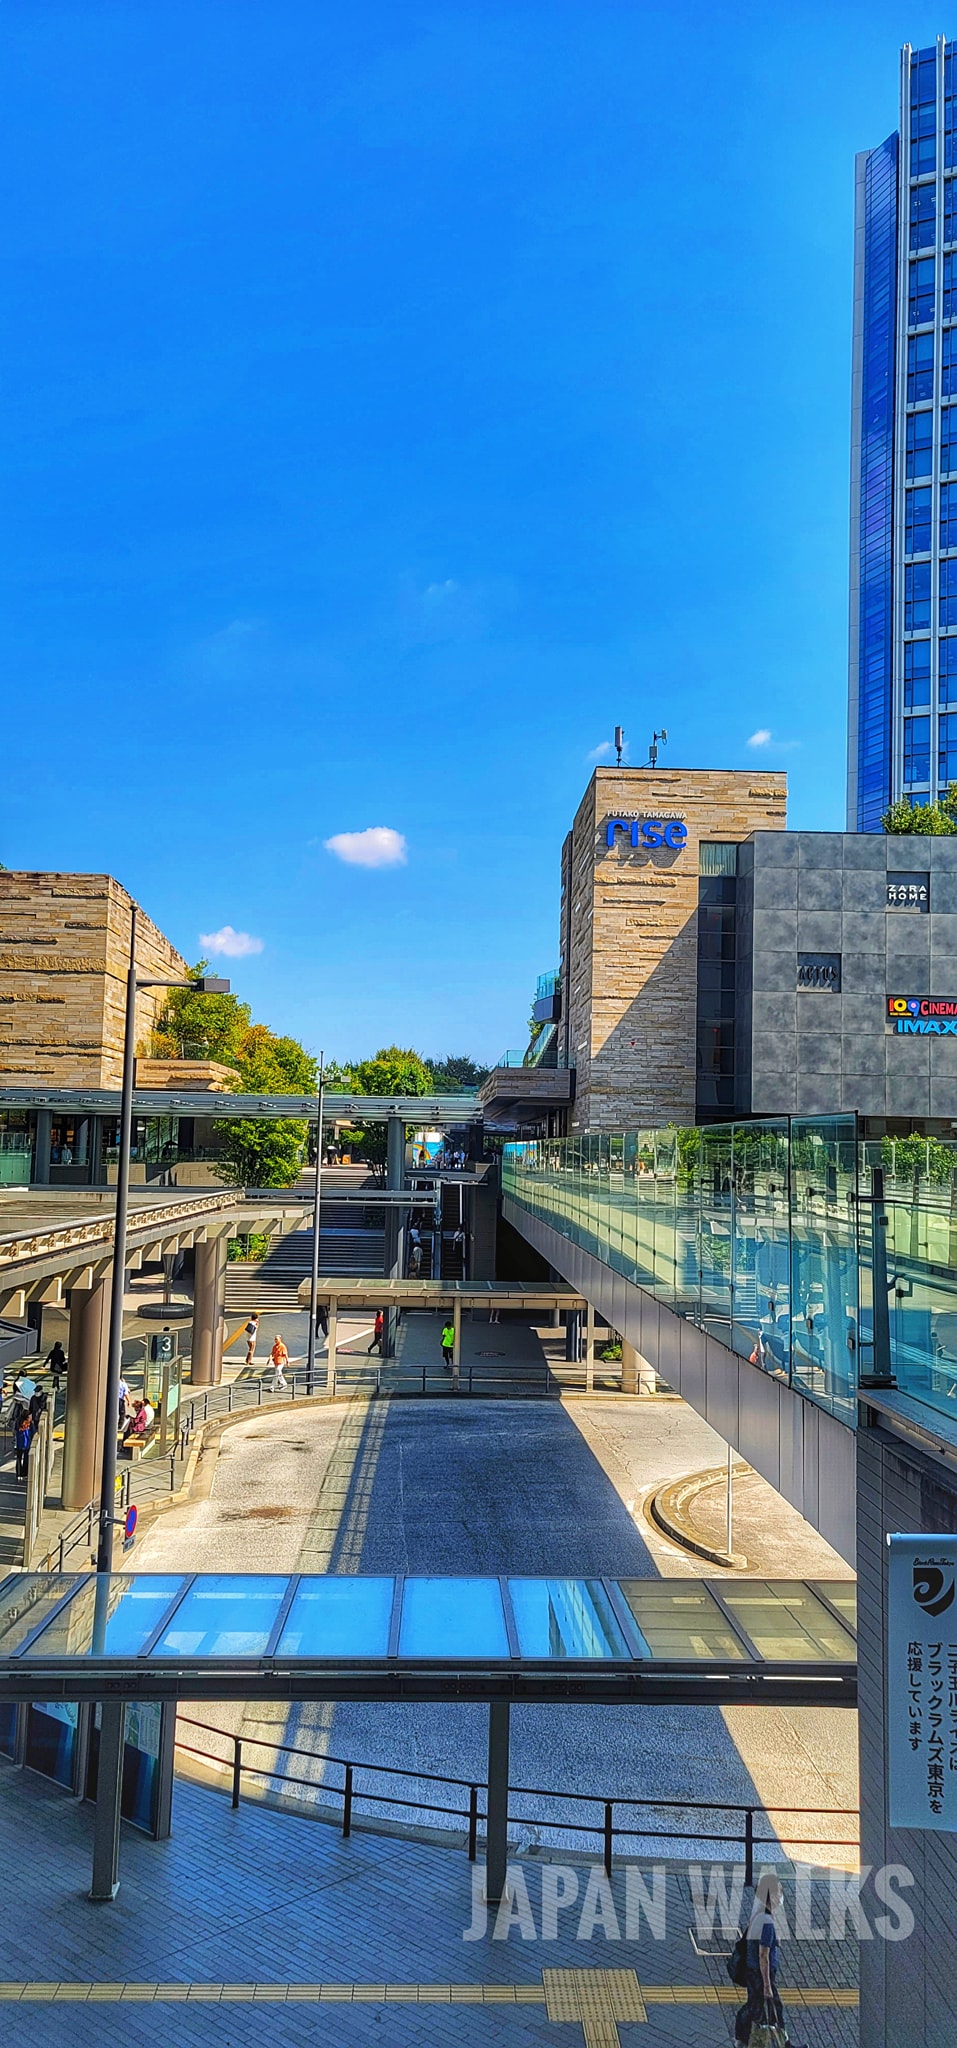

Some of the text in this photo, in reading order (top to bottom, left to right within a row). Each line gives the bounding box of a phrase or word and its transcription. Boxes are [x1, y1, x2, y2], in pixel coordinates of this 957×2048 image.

[643, 811, 688, 819] TAMAGAWA
[606, 819, 688, 849] rise
[888, 884, 927, 892] ZARA
[888, 892, 928, 900] HOME
[889, 998, 920, 1017] 109
[897, 1020, 957, 1034] IMAX
[161, 1336, 172, 1352] 3
[907, 1641, 923, 1751] 応援しています
[927, 1642, 945, 1814] ブラックラムズ東京を
